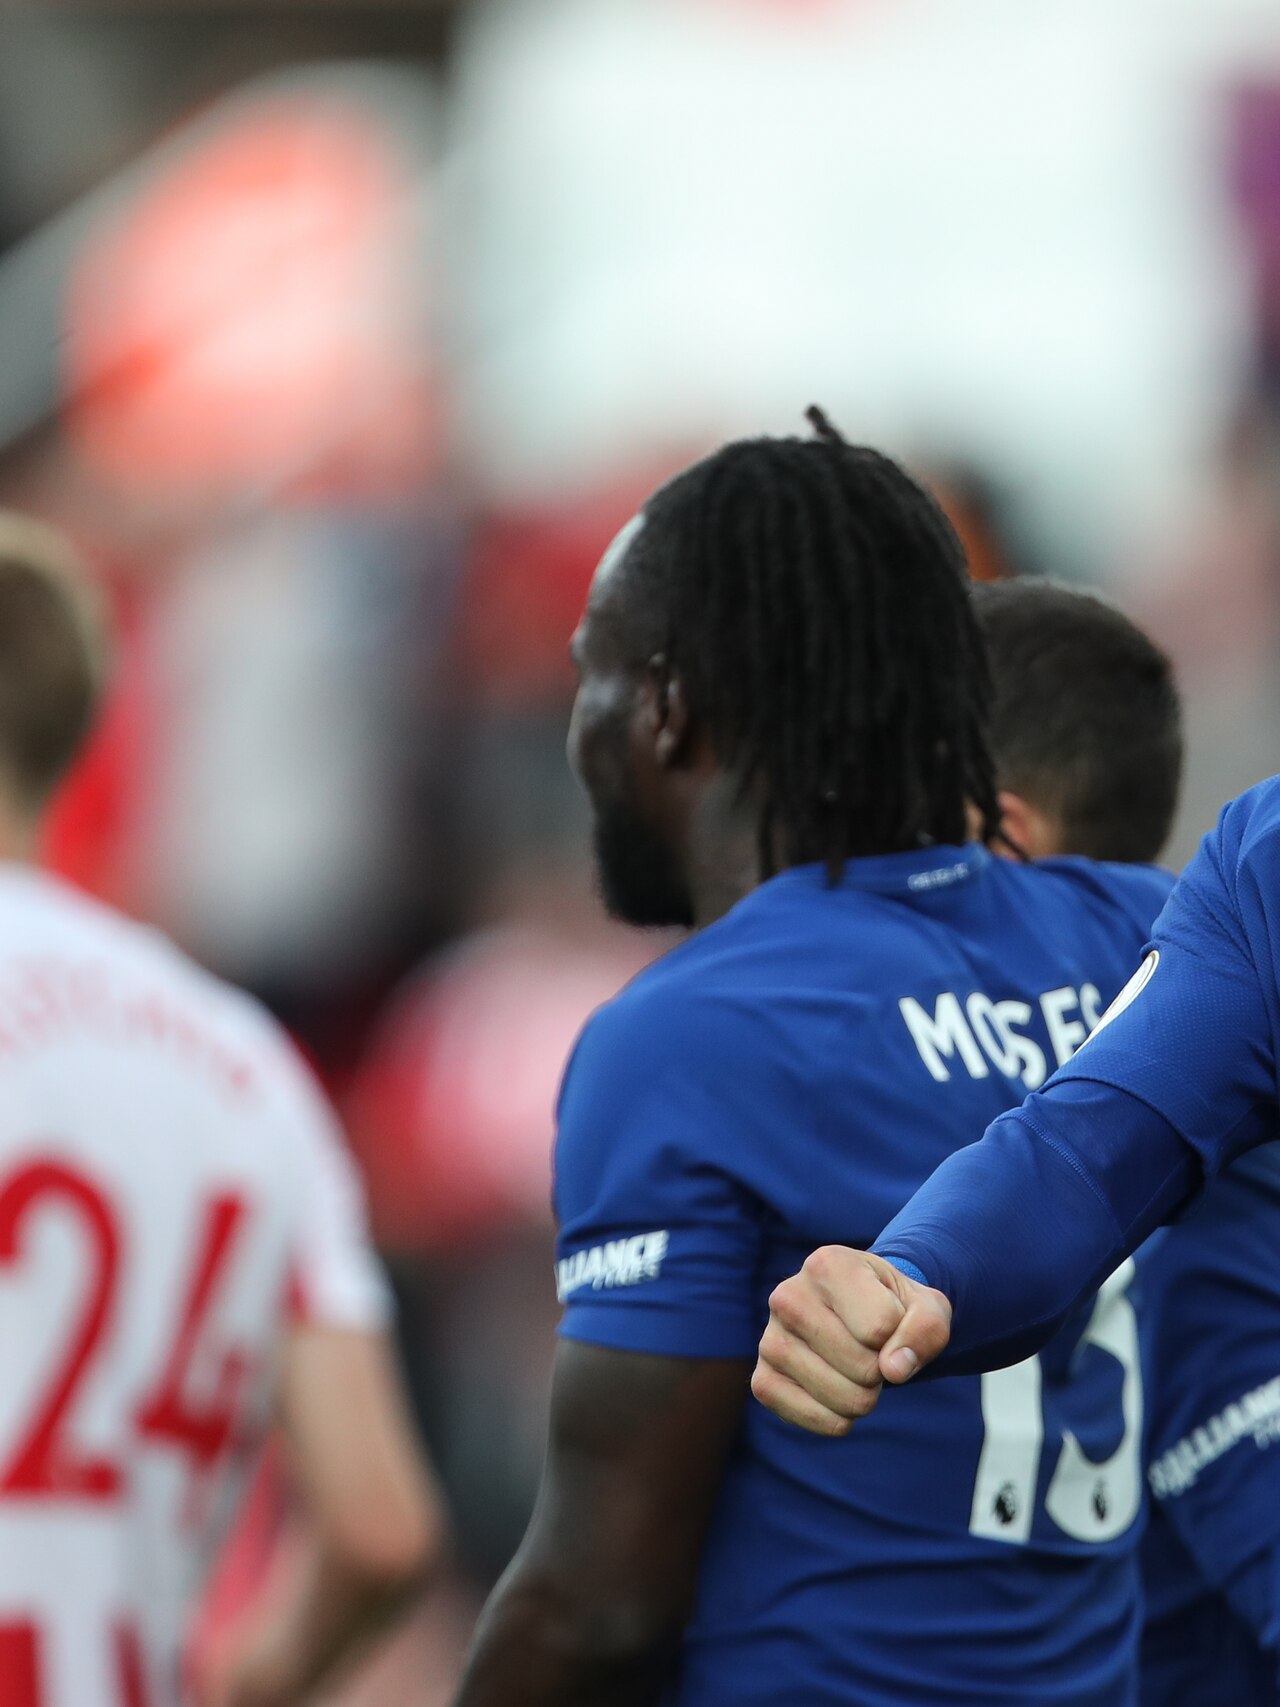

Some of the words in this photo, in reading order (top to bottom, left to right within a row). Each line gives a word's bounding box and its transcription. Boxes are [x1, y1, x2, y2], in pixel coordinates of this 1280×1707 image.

[0, 1152, 252, 1505] 24
[556, 1229, 669, 1304] LLIANCE
[968, 1255, 1144, 1546] 13
